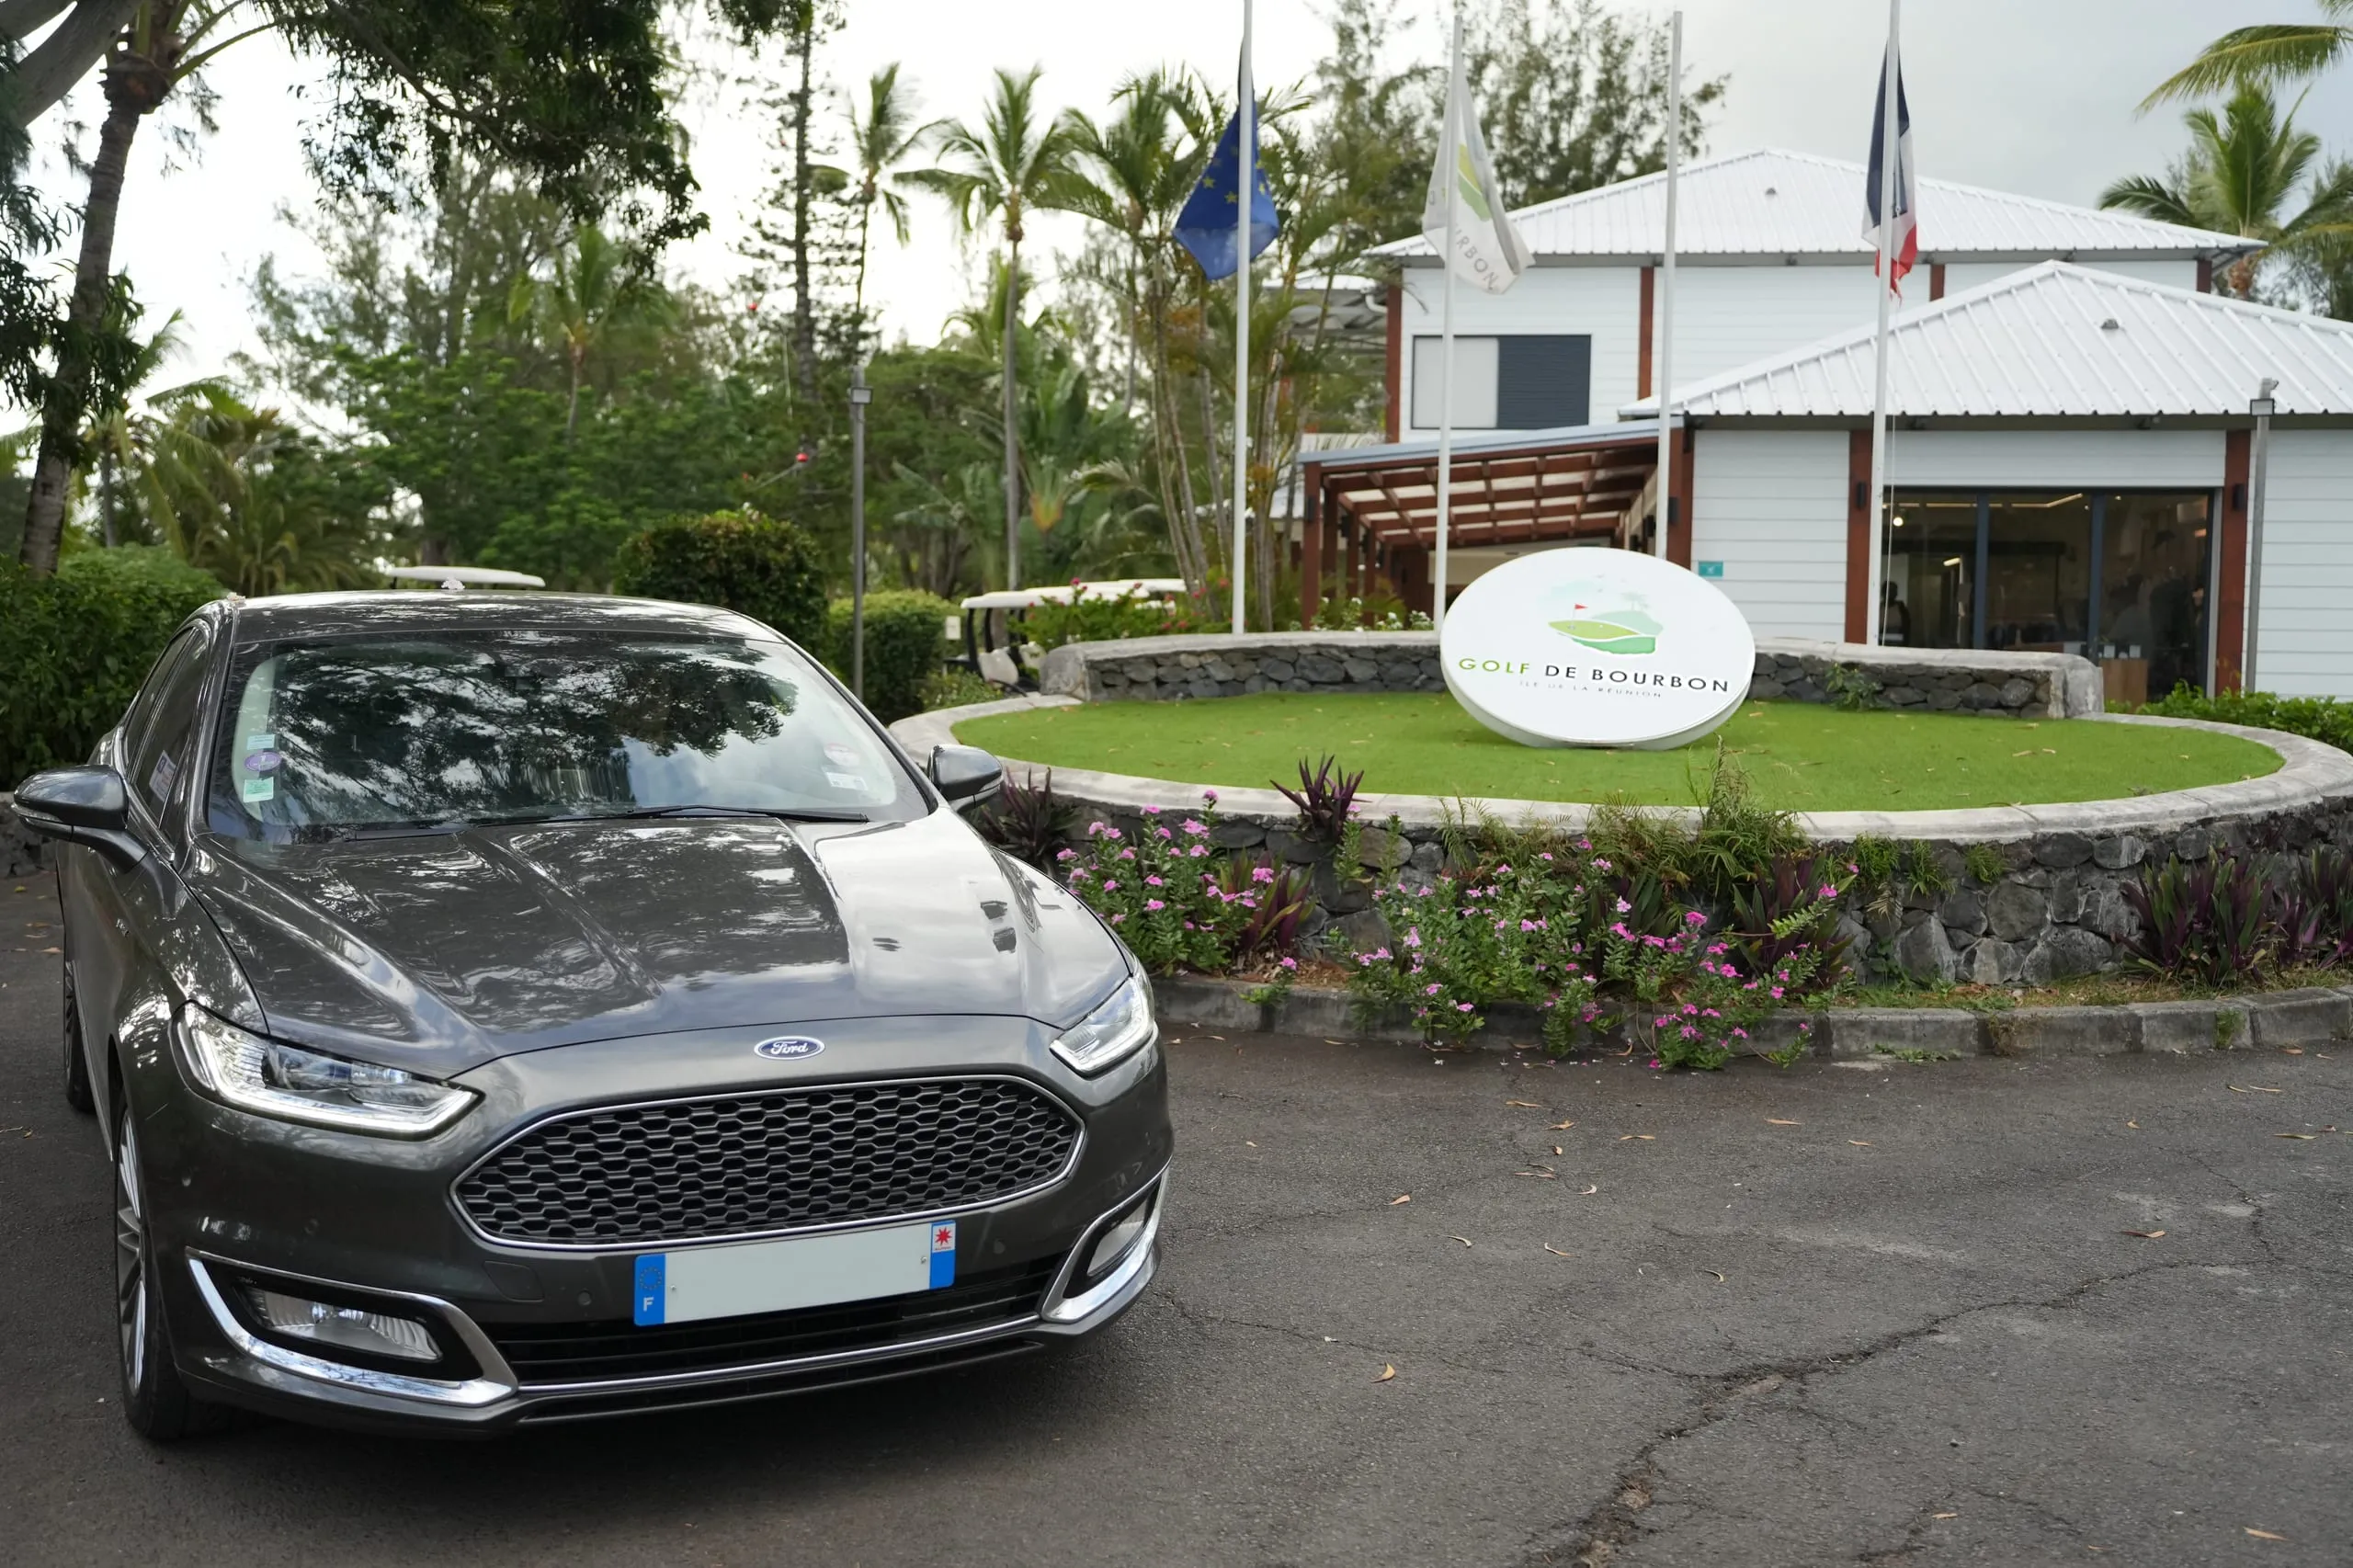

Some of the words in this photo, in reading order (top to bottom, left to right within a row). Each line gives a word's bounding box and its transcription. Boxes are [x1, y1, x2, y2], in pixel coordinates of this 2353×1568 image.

[1459, 658, 1530, 675] GOLF
[1545, 665, 1577, 679] DE
[1592, 668, 1728, 692] BOURBON
[770, 1040, 809, 1055] Ford
[642, 1297, 654, 1312] F
